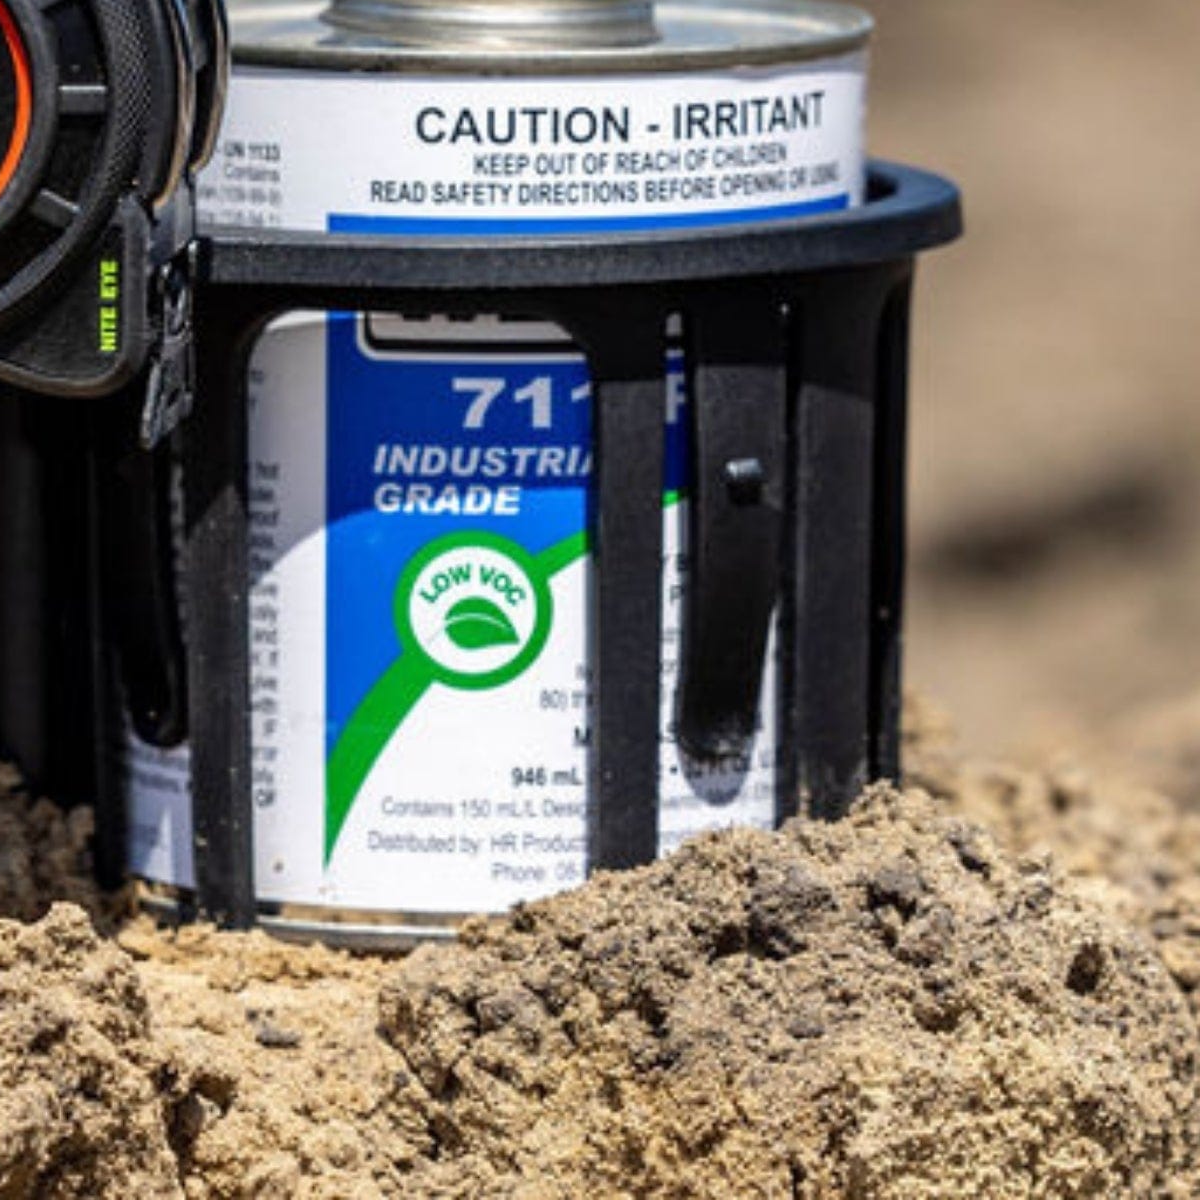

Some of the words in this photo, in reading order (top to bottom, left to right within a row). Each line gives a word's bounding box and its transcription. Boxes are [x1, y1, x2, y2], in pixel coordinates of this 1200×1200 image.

[415, 106, 629, 145] CAUTION
[646, 123, 661, 134] -
[672, 90, 825, 141] IRRITANT
[473, 153, 529, 176] KEEP
[533, 153, 576, 176] OUT
[582, 152, 609, 174] OF
[614, 151, 680, 174] REACH
[684, 149, 708, 171] OF
[712, 142, 787, 168] CHILDREN
[370, 179, 426, 203] READ
[430, 181, 512, 205] SAFETY
[518, 180, 639, 205] DIRECTIONS
[644, 176, 715, 201] BEFORE
[719, 169, 786, 196] OPENING
[100, 260, 118, 300] EYE
[374, 482, 521, 515] GRADE
[420, 563, 471, 603] LOW
[479, 564, 526, 606] VOC
[511, 766, 546, 788] 946
[553, 766, 583, 786] mL
[382, 795, 453, 818] Contains
[367, 830, 455, 853] Distributed
